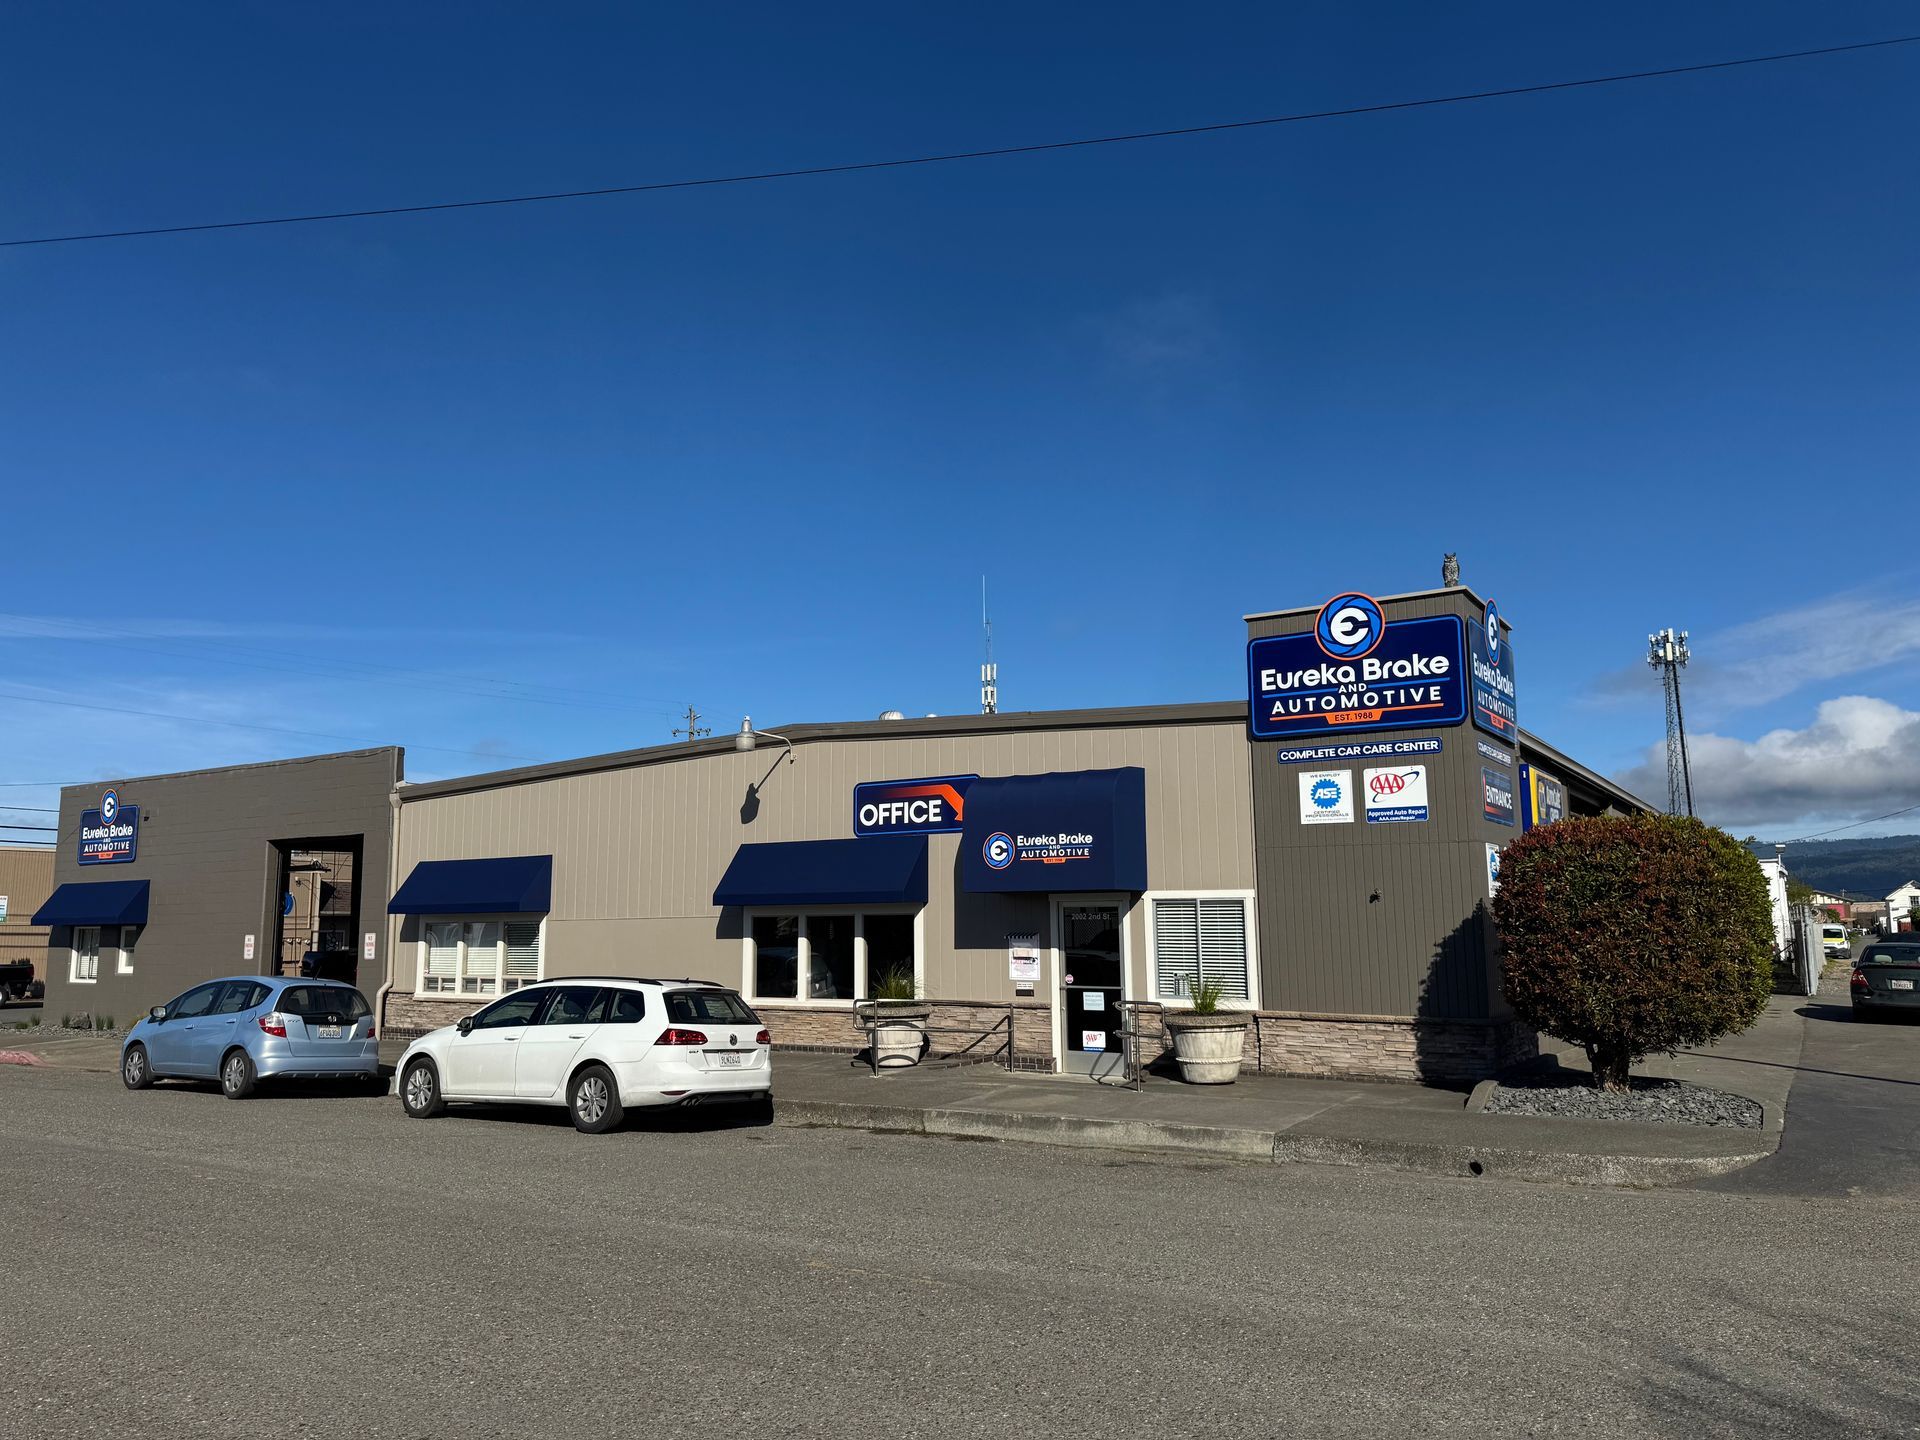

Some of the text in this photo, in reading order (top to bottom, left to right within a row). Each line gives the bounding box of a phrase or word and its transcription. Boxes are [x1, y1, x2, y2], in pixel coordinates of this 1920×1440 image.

[1261, 653, 1449, 691] Eureka Brake
[1473, 652, 1513, 698] Eureka Brake
[1338, 683, 1367, 693] AND
[1271, 686, 1441, 715] AUTOMOTIVE
[1478, 689, 1514, 721] AUTOMOTIVE
[1334, 711, 1373, 722] EST. 1988
[1280, 740, 1439, 760] COMPLETE CAR CARE CENTER
[1373, 774, 1402, 794] AAA
[1314, 787, 1338, 799] ASE
[1485, 785, 1512, 809] ENTRANCE
[860, 800, 941, 826] OFFICE
[1368, 809, 1394, 817] Approved
[82, 824, 133, 839] Eureka Brake
[84, 841, 129, 852] AUTOMOTIVE
[1017, 833, 1093, 846] Eureka Brake
[1021, 848, 1089, 858] AUTOMOTIVE
[1088, 912, 1101, 920] 2nd
